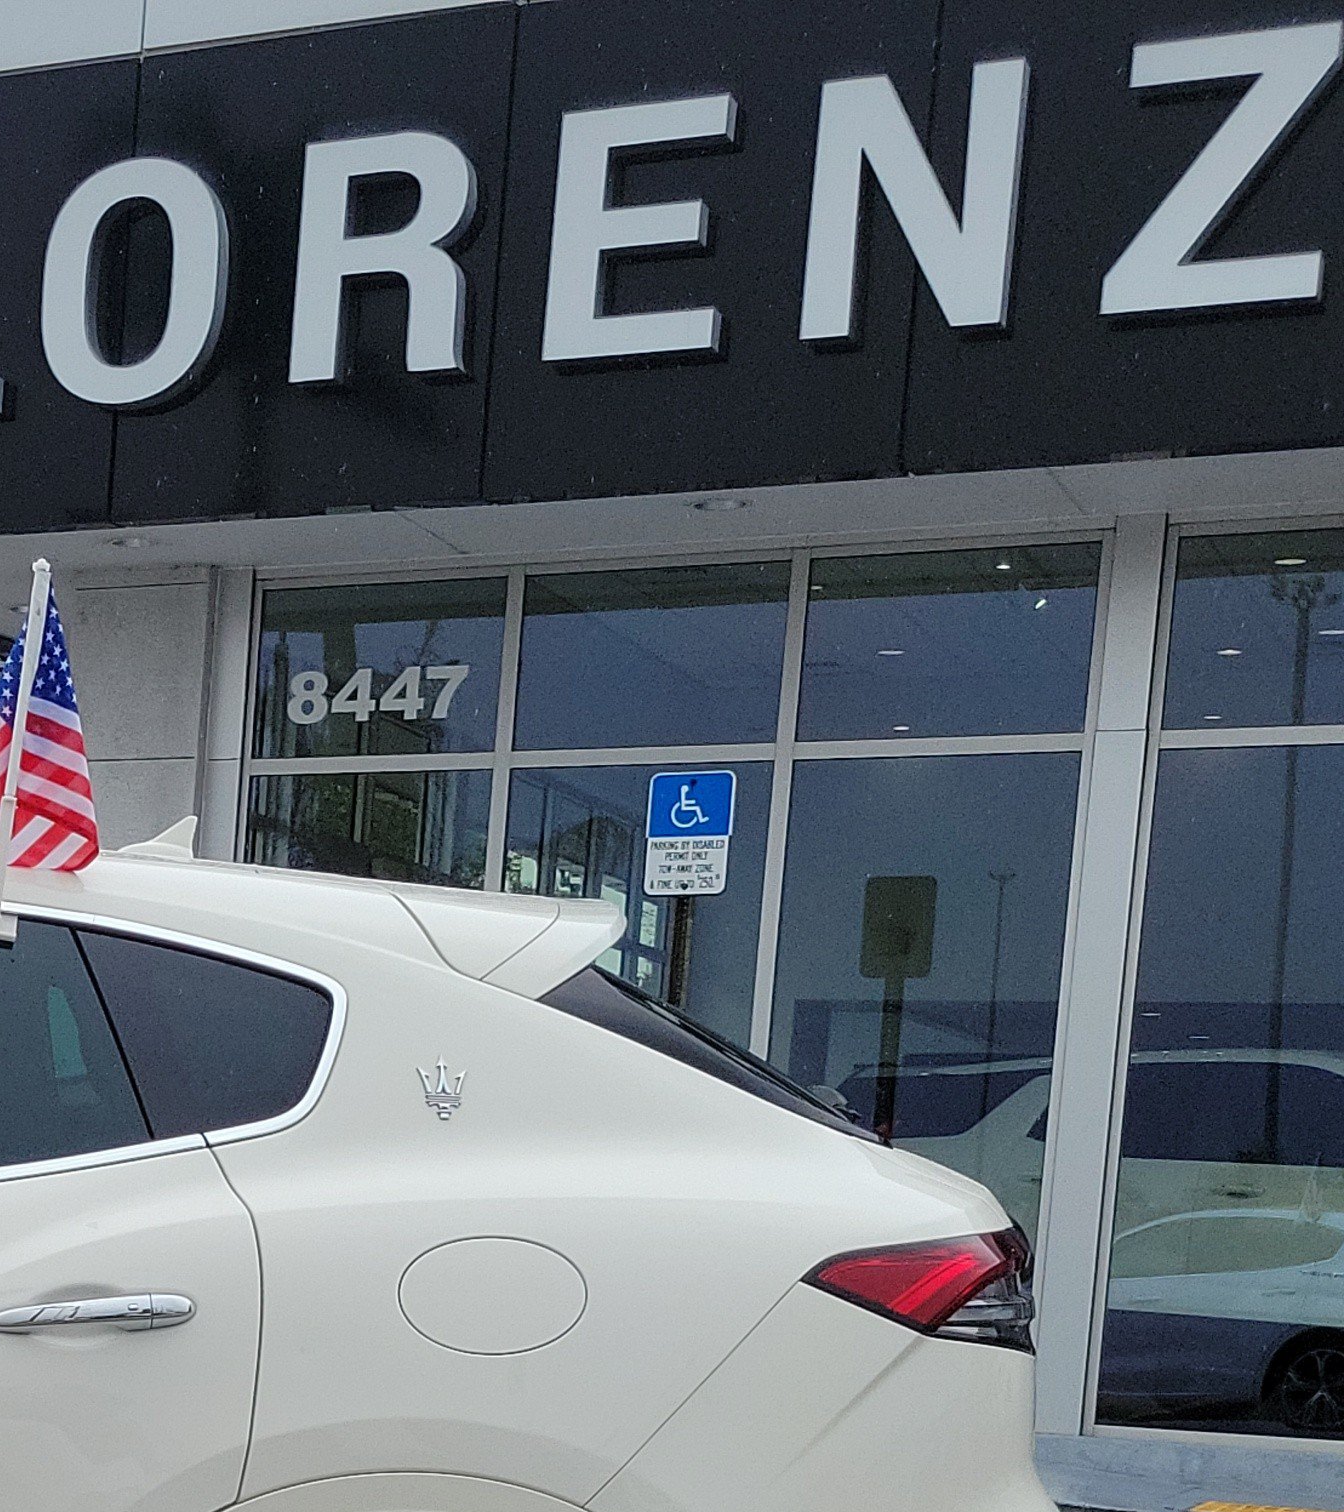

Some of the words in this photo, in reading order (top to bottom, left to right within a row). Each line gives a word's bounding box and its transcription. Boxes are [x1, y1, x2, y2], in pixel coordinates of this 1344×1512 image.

[287, 664, 470, 725] 8447
[650, 841, 679, 850] PARKING
[681, 841, 690, 850] BY
[693, 839, 725, 849] DISABLED
[664, 852, 689, 861] PERMIT
[692, 851, 708, 860] ONLY
[695, 864, 714, 873] ZONE
[657, 880, 672, 889] FINE
